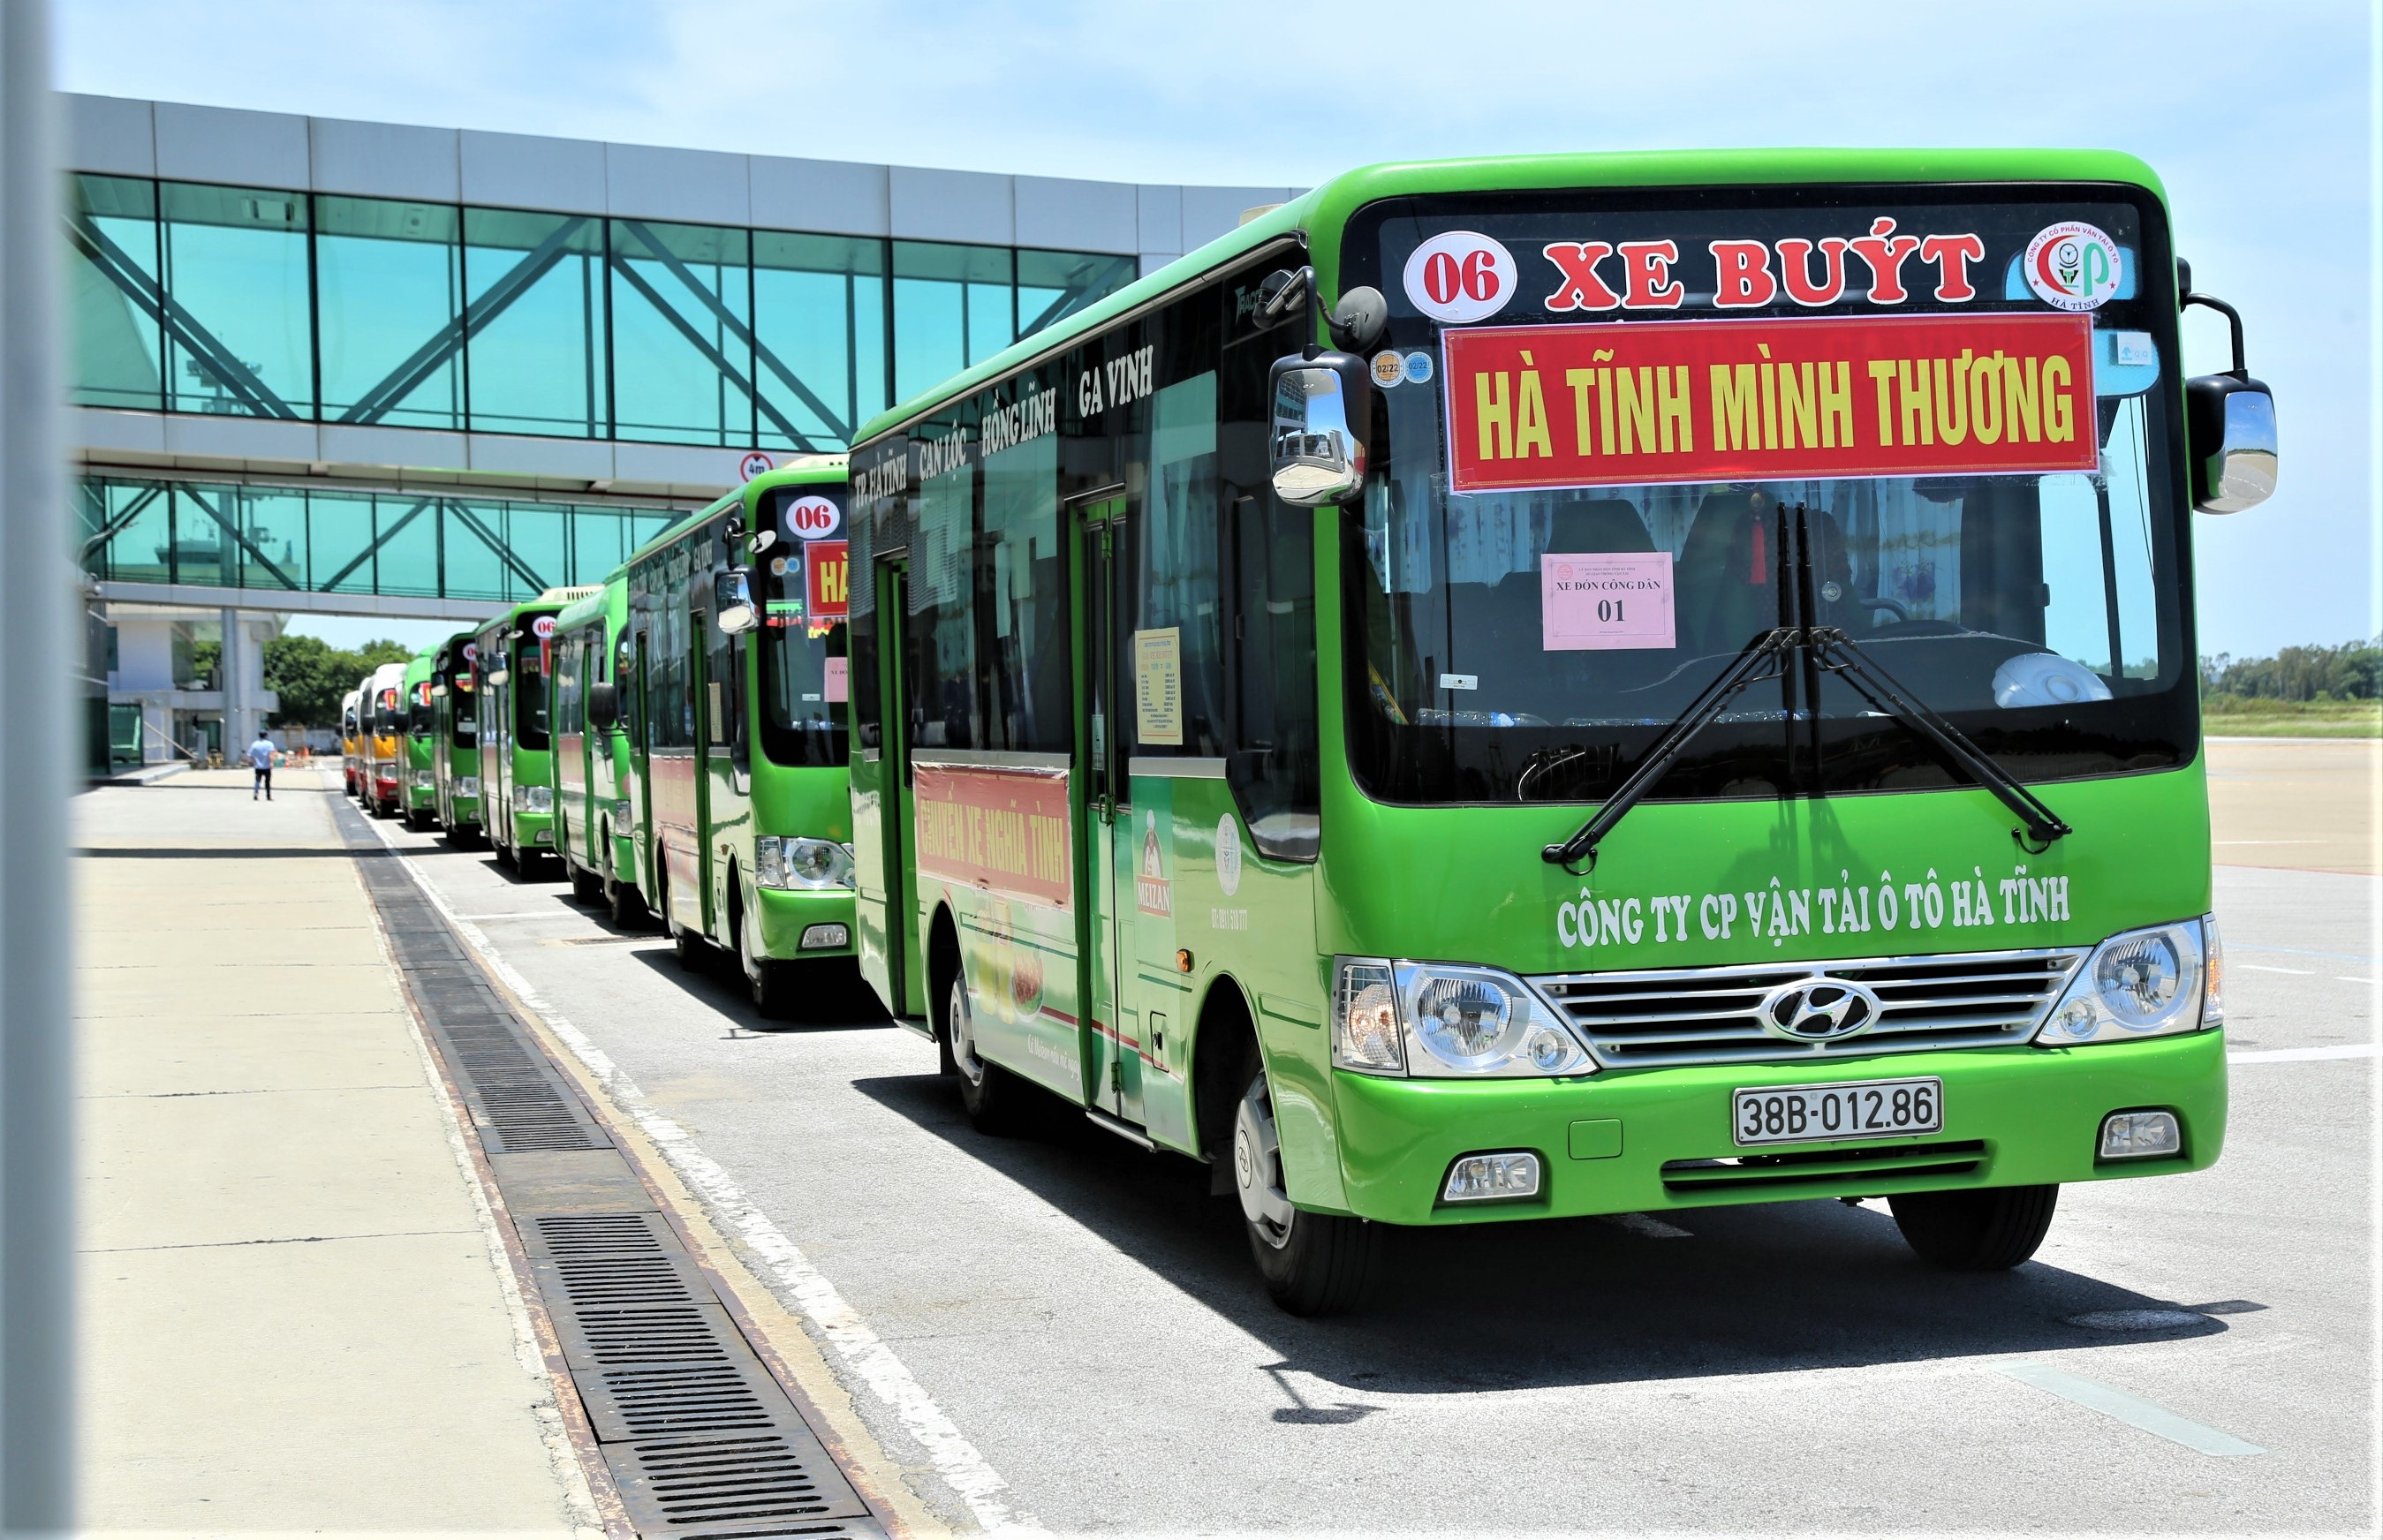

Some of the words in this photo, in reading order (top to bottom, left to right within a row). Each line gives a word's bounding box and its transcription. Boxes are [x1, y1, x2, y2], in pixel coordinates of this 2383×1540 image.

[1424, 250, 1499, 305] 06
[1543, 239, 1684, 311] XE
[1709, 216, 1986, 308] BUÝT
[1079, 366, 1104, 419] GA
[1107, 344, 1154, 410] VINH
[1377, 363, 1399, 374] 02/22
[981, 388, 1020, 458] HỒNG
[1019, 381, 1056, 445] LĨNH
[1474, 350, 1554, 461] HÀ
[1565, 348, 1693, 457] TĨNH
[1709, 343, 1855, 453] MÌNH
[1868, 348, 2075, 447] THƯƠNG
[882, 448, 908, 498] TĨNH
[919, 440, 942, 482] CAN
[943, 419, 967, 482] LỘC
[795, 504, 832, 531] 06
[1556, 582, 1572, 591] XE
[1575, 579, 1599, 591] ĐÓN
[1601, 578, 1635, 591] CÔNG
[1638, 578, 1661, 590] DÂN
[1597, 600, 1624, 622] 01
[538, 621, 556, 633] 06
[919, 781, 965, 861] CHUYẾN
[965, 805, 986, 867] XE
[985, 799, 1028, 877] NGHĨA
[1029, 802, 1065, 884] TÌNH
[1137, 881, 1170, 913] MEIZAN
[1556, 886, 1645, 948] CÔNG
[1650, 894, 1691, 944] TY
[1699, 892, 1738, 940] CP
[1744, 876, 1811, 947] VẬN
[1818, 867, 1872, 935] TẢI
[1879, 869, 1900, 932] Ô
[1904, 867, 1943, 930] TÔ
[1950, 864, 1995, 927] HÀ
[1999, 864, 2070, 925] TĨNH
[1742, 1079, 1934, 1137] 38B-012.86
